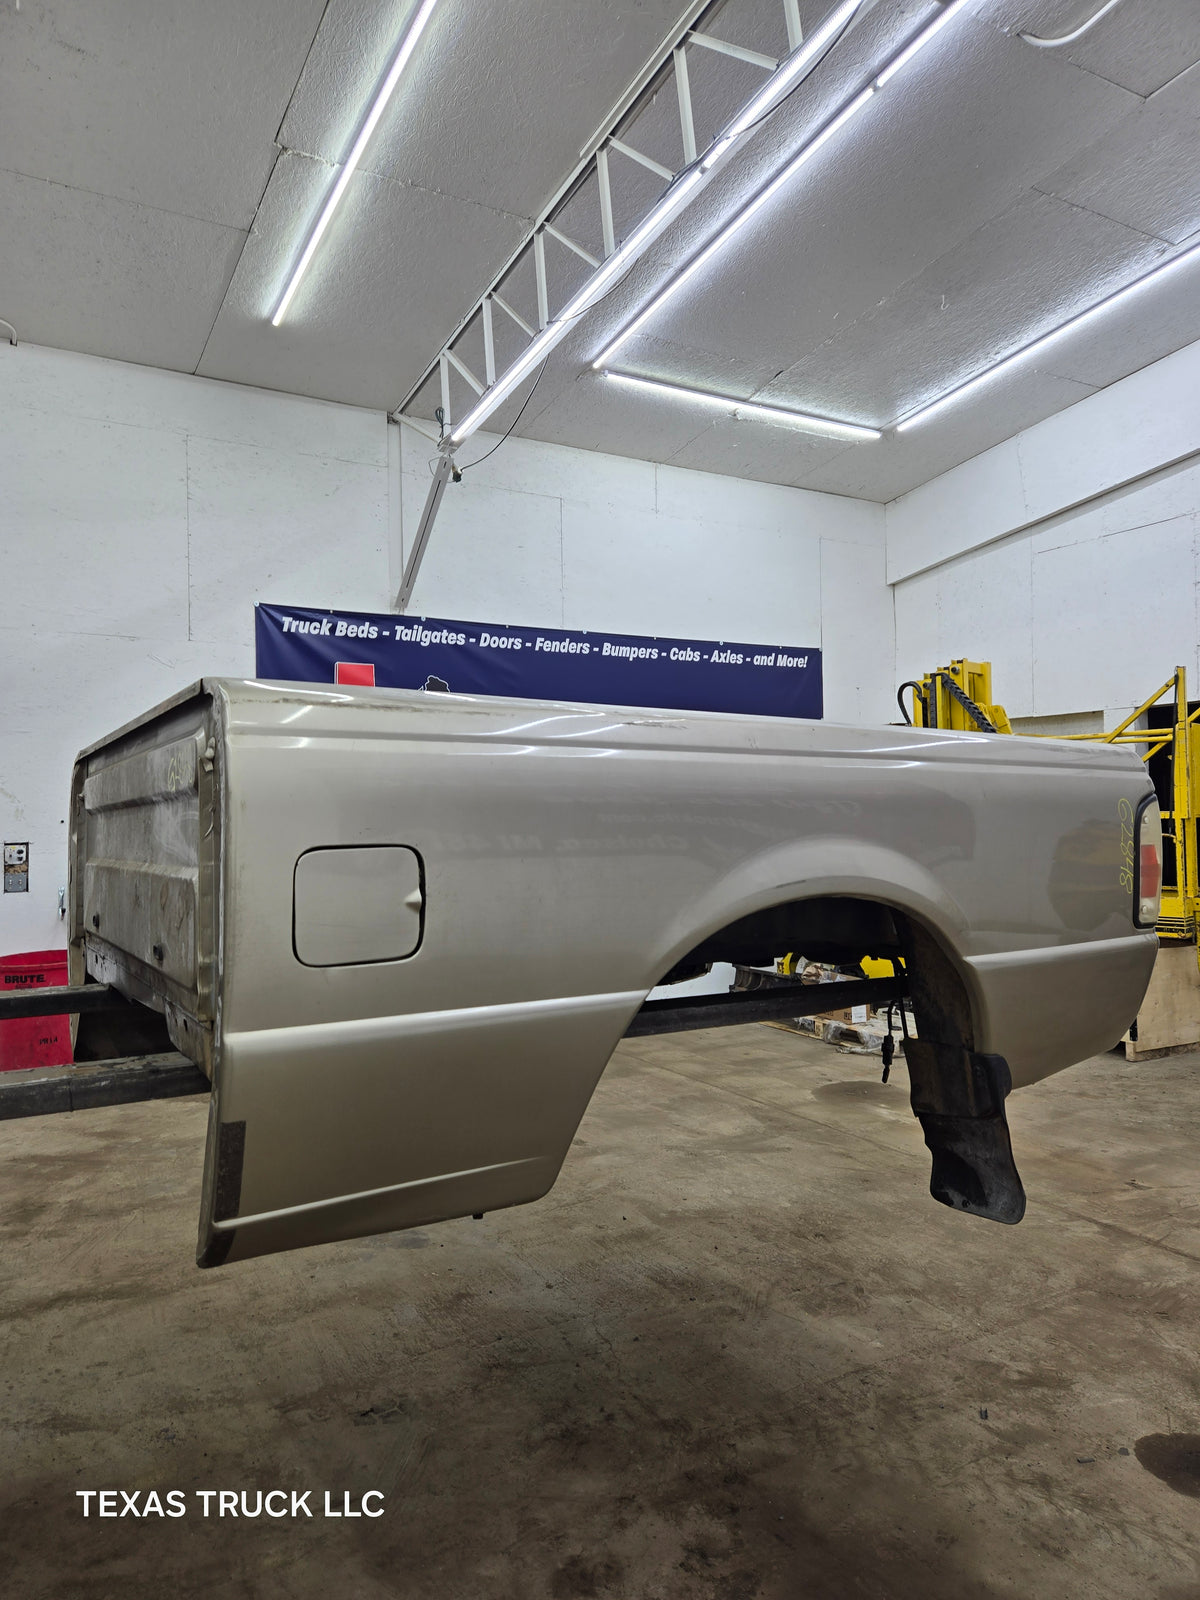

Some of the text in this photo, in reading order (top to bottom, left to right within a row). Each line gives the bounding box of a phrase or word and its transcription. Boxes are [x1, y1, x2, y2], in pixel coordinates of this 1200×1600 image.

[282, 616, 332, 636] Truck
[335, 621, 378, 639] Beds
[395, 625, 465, 647] Tailgates
[479, 632, 522, 650] Doors
[535, 637, 590, 655] Fenders
[602, 642, 658, 662] Bumpers
[670, 647, 700, 662] Cabs
[710, 650, 743, 665] Axles
[753, 652, 775, 667] and
[777, 655, 808, 669] More!
[1118, 798, 1135, 894] 62848
[4, 974, 45, 984] BRUTE
